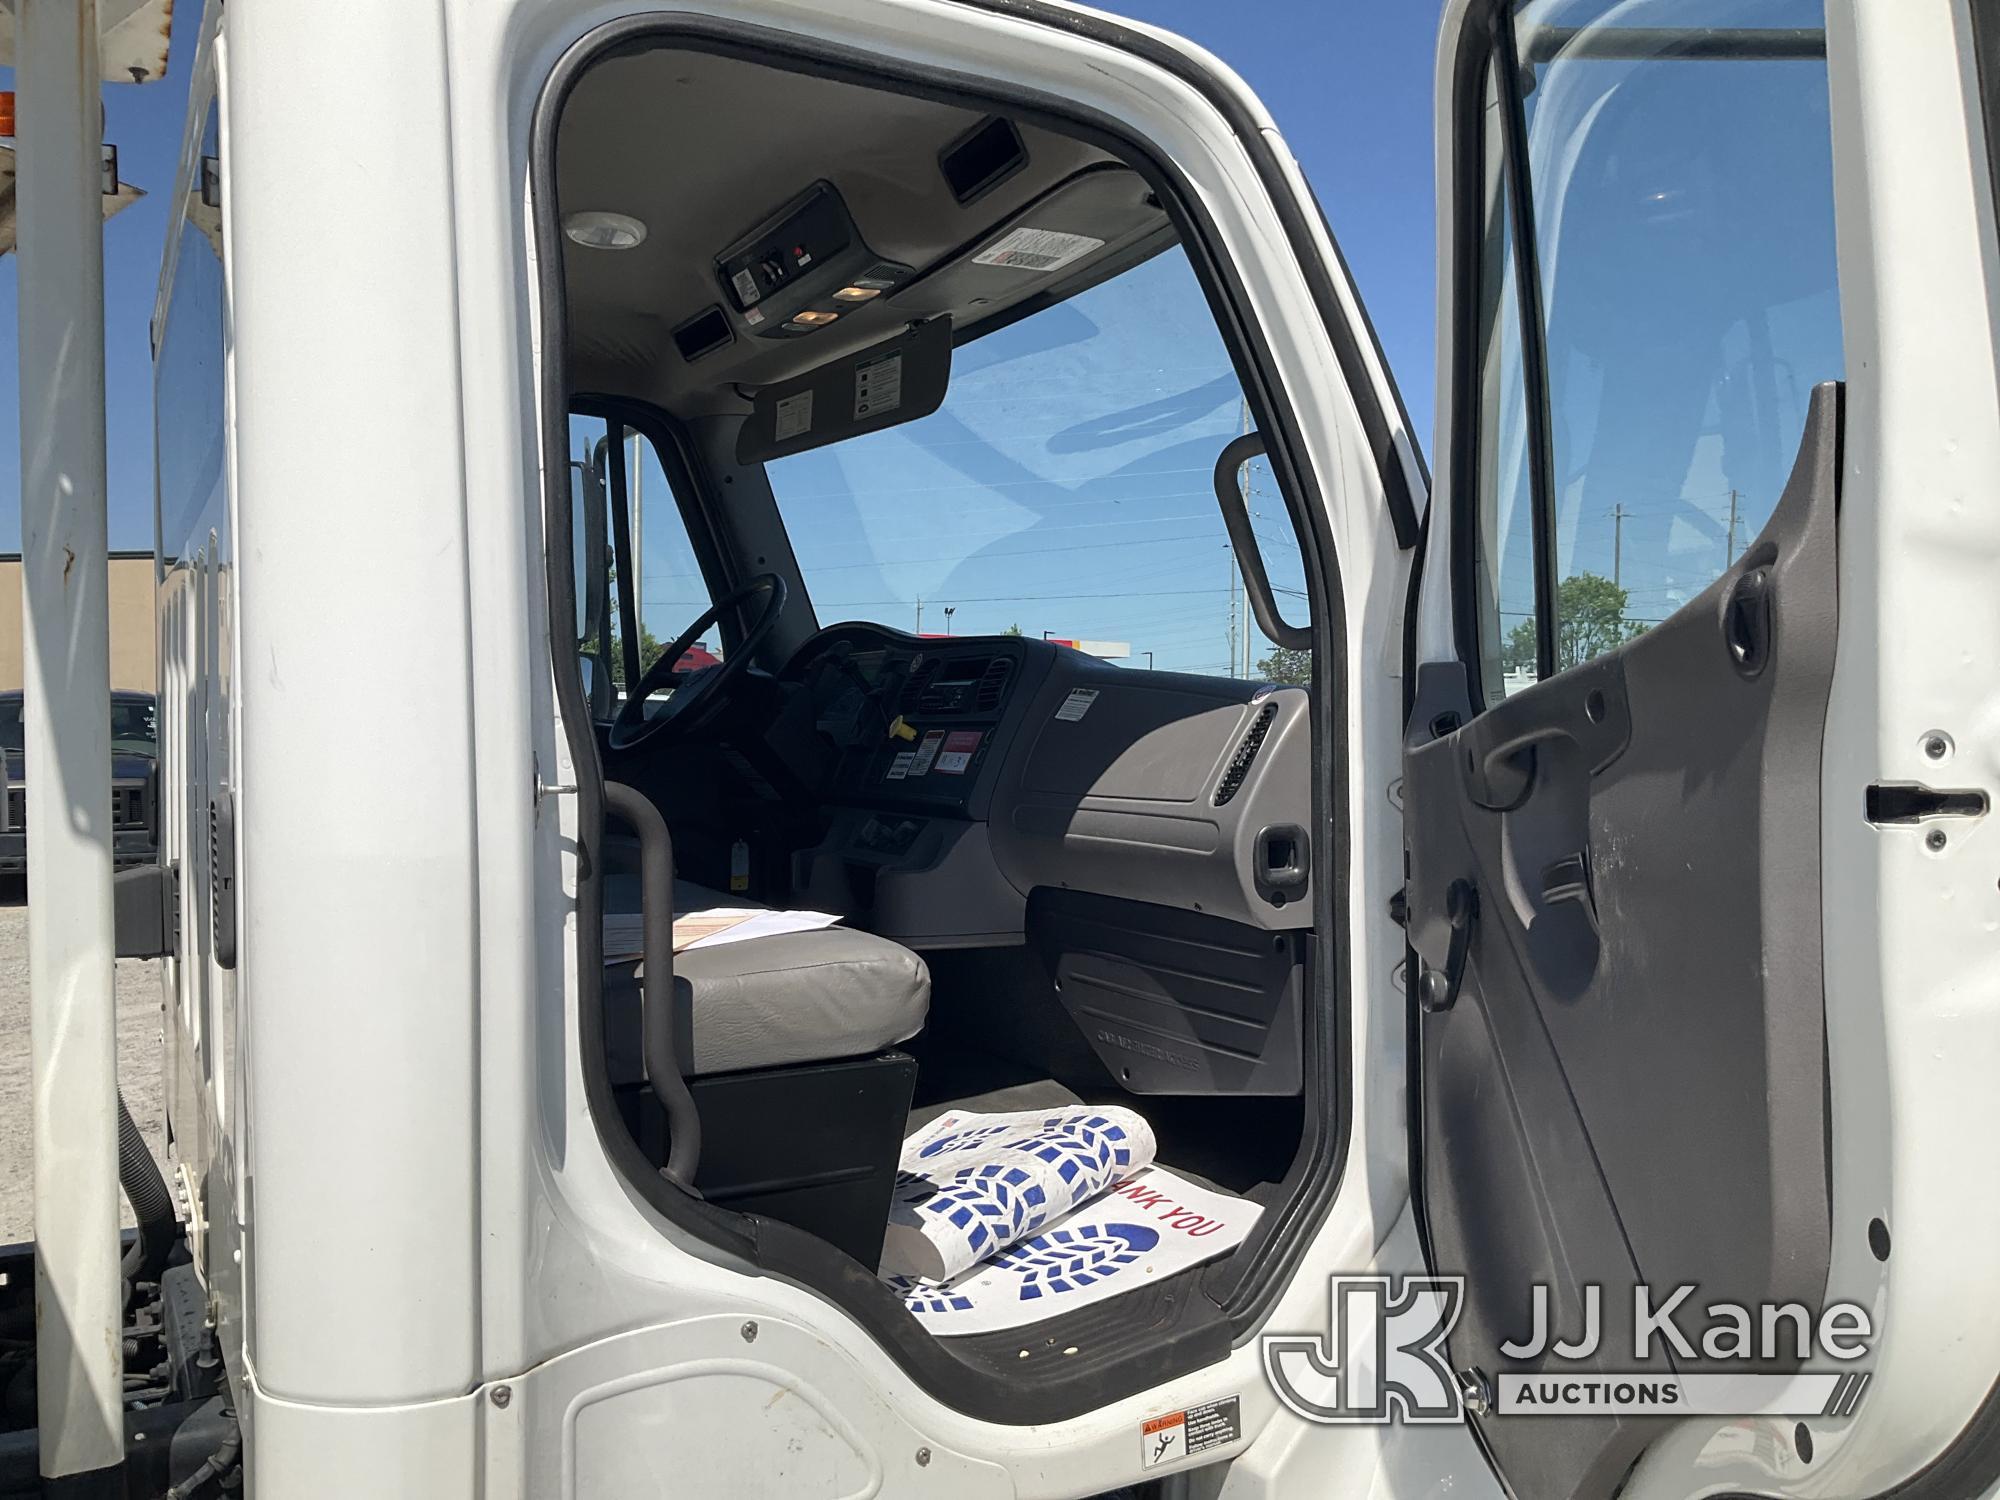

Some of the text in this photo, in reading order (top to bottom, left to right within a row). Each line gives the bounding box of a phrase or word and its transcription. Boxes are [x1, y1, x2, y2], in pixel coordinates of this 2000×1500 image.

[1110, 1180, 1225, 1237] ANK YOU
[1152, 1415, 1183, 1430] WARNING
